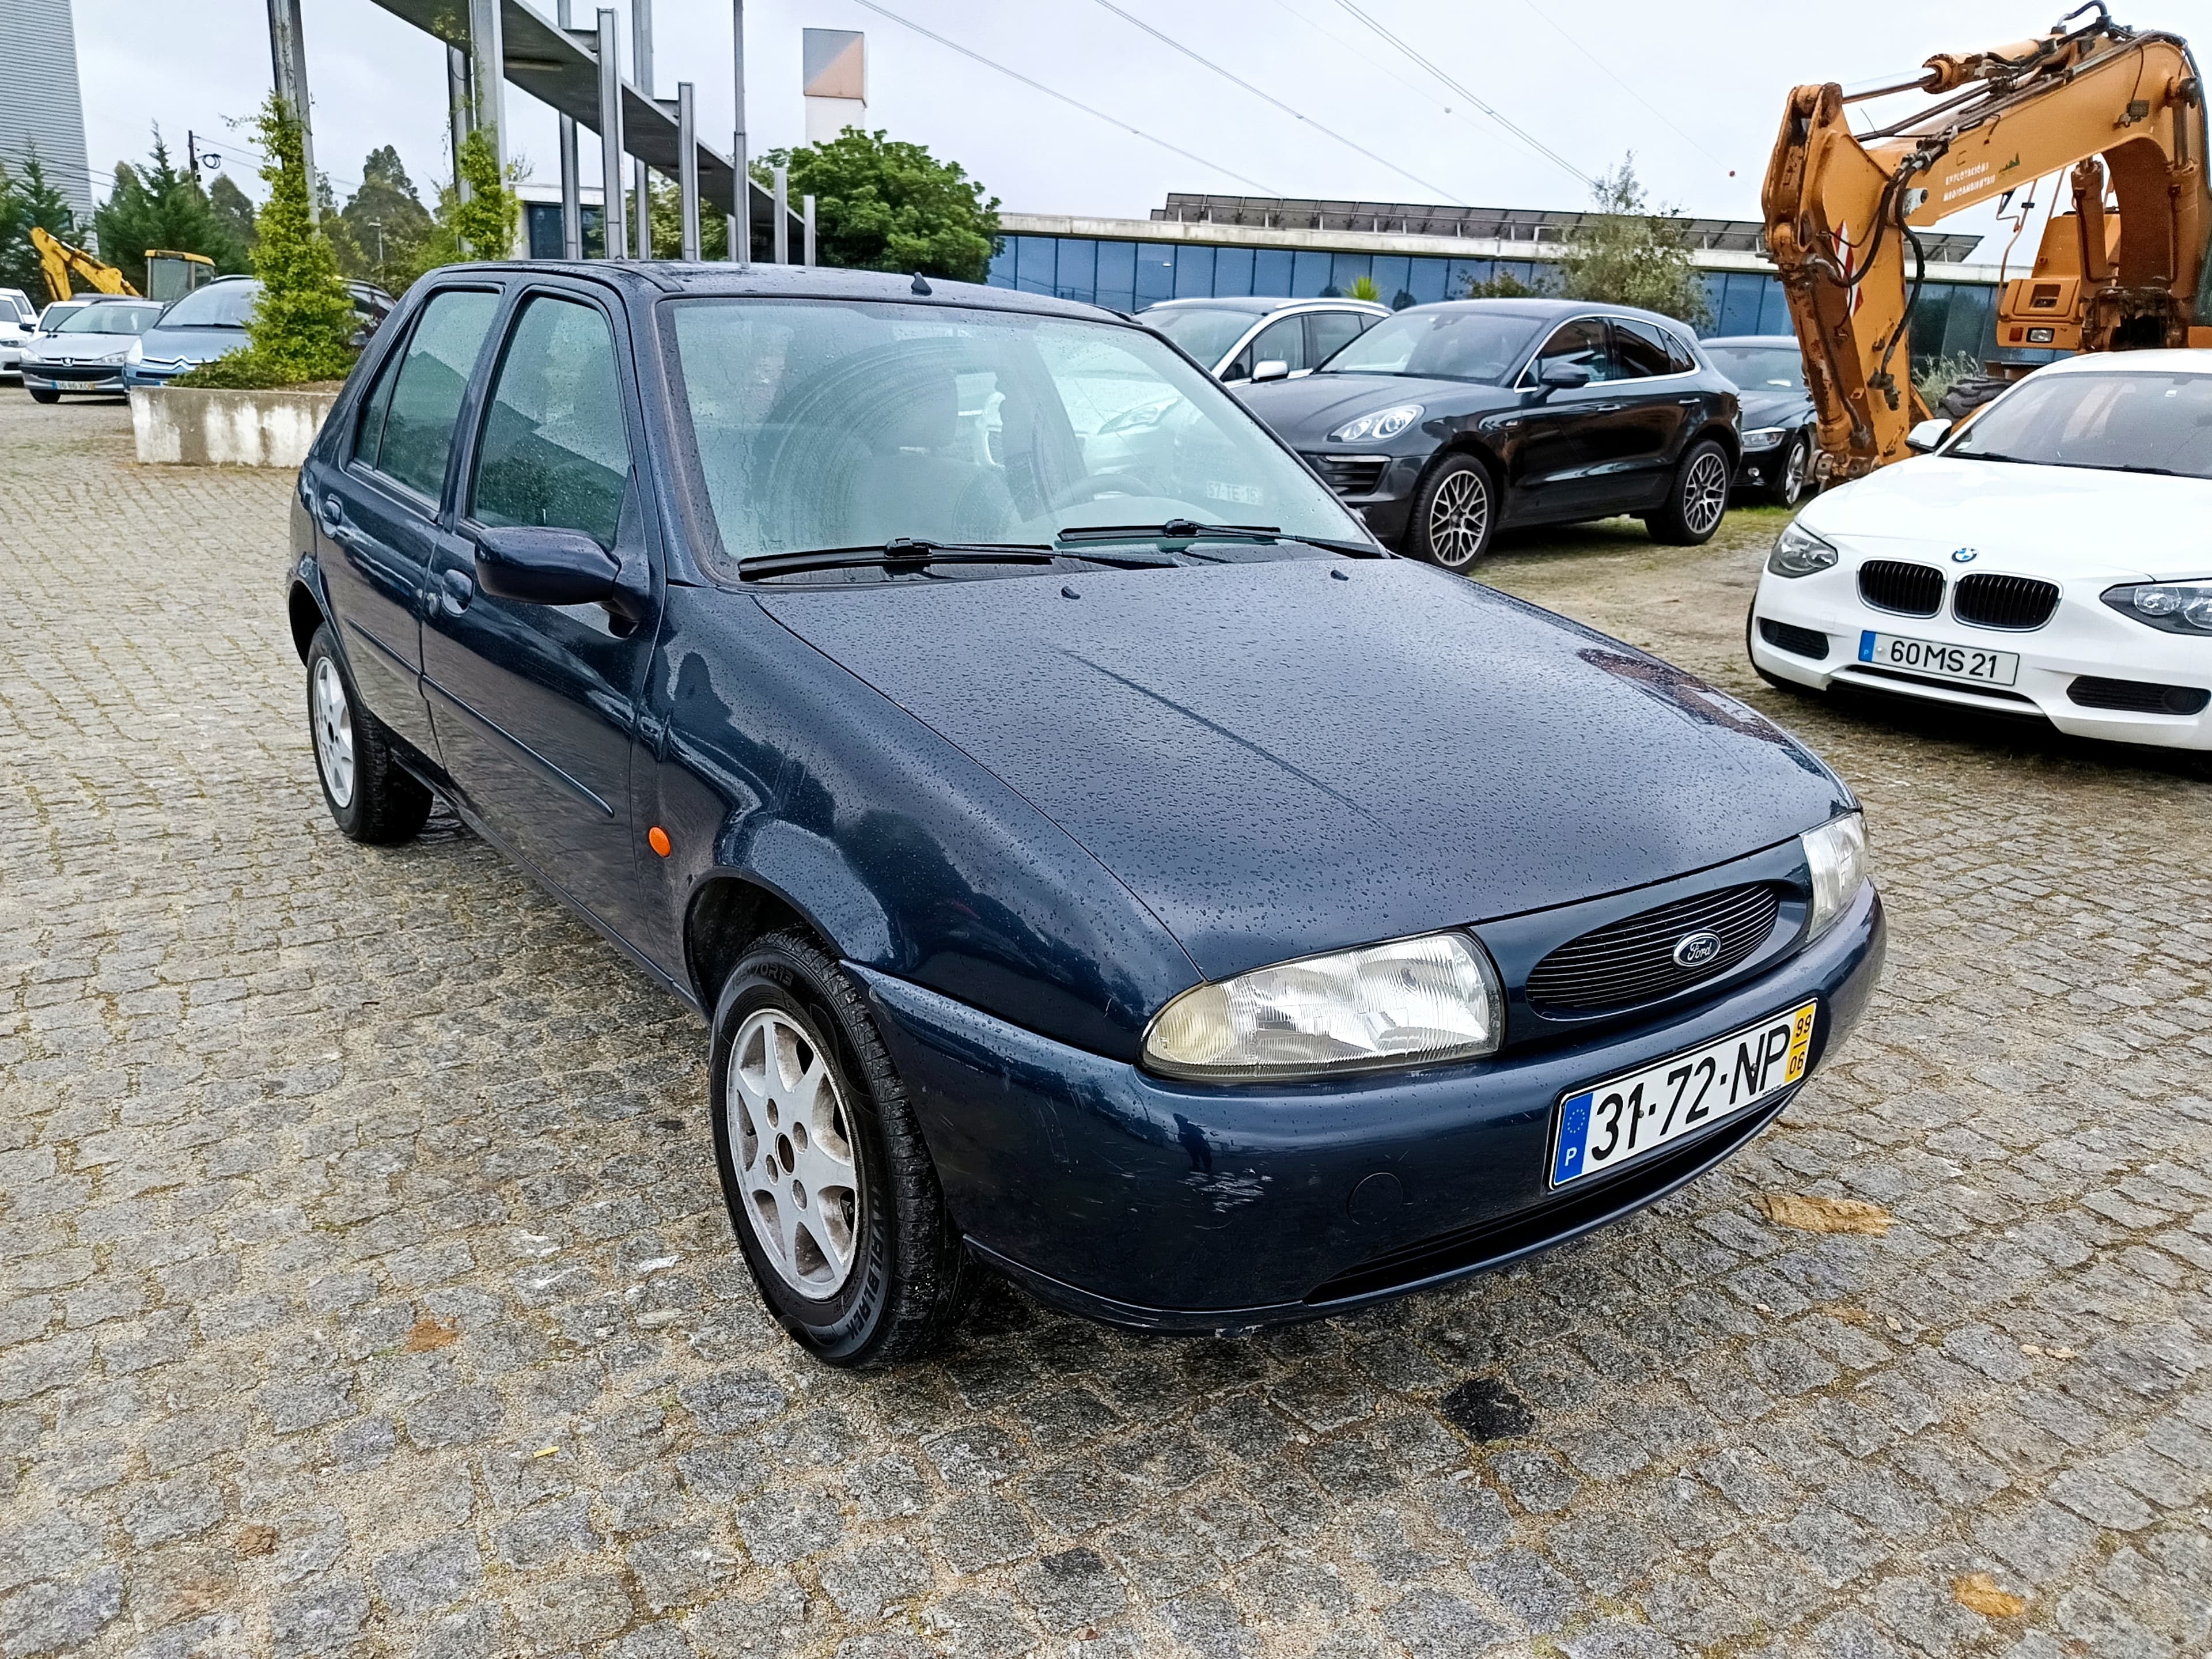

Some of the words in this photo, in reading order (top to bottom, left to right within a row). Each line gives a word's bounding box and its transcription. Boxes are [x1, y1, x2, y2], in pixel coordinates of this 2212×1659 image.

[1687, 940, 1712, 961] Ford
[1795, 1016, 1812, 1038] 99
[1789, 1051, 1804, 1075] 06
[1565, 1147, 1577, 1167] P
